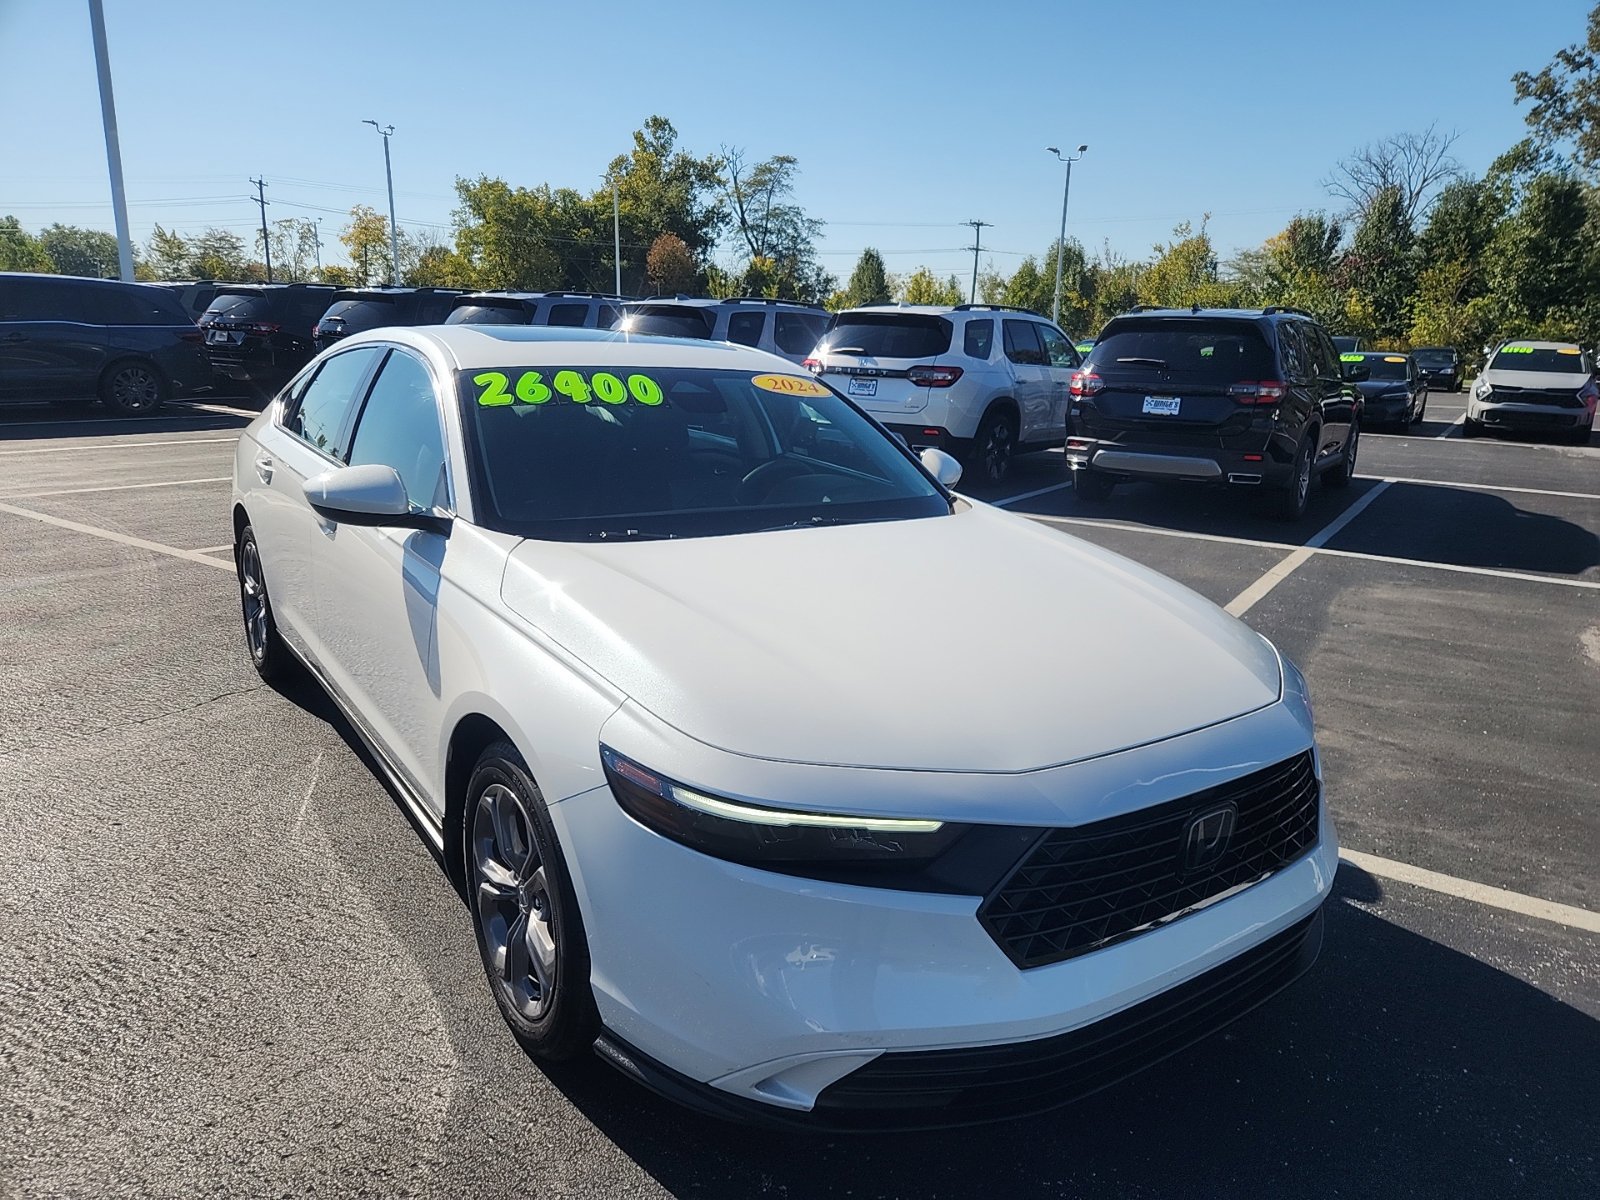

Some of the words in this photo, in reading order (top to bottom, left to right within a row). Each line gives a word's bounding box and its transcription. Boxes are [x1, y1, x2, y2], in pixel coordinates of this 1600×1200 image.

[835, 367, 889, 375] PILOT
[473, 370, 664, 406] 26400
[767, 378, 819, 393] 2024
